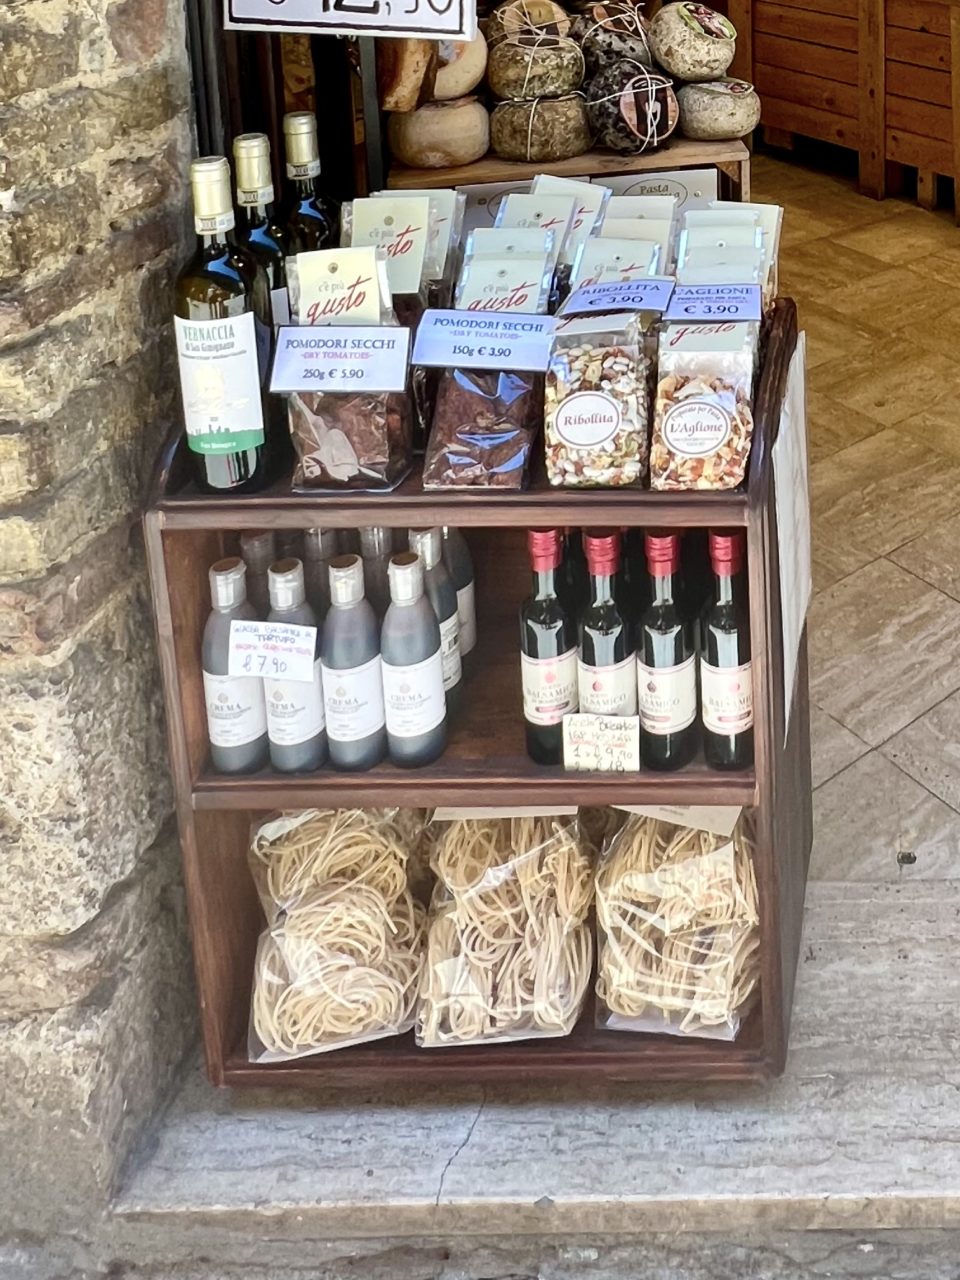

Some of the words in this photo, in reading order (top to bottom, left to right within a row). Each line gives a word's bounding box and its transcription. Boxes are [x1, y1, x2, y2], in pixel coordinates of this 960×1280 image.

[640, 184, 669, 194] Pasta
[581, 284, 661, 296] RIBOLLITA
[307, 275, 372, 325] gusto
[588, 298, 600, 306] €
[606, 295, 644, 305] 3.90
[684, 305, 697, 314] €
[702, 305, 739, 314] 3.90
[433, 318, 499, 330] POMODORI
[502, 322, 544, 333] SECCHI
[183, 324, 235, 341] VERNACCIA
[670, 322, 736, 346] gusto
[285, 339, 348, 350] POMODORI
[351, 339, 396, 350] SECCHI
[452, 345, 475, 356] 150g
[477, 346, 487, 356] €
[488, 347, 511, 357] 3.90
[302, 369, 325, 380] 250g
[328, 369, 337, 379] €
[341, 369, 364, 379] 5.90
[563, 413, 614, 428] Ribollita
[671, 420, 723, 437] L'Aglione
[254, 634, 296, 644] TARTUFO
